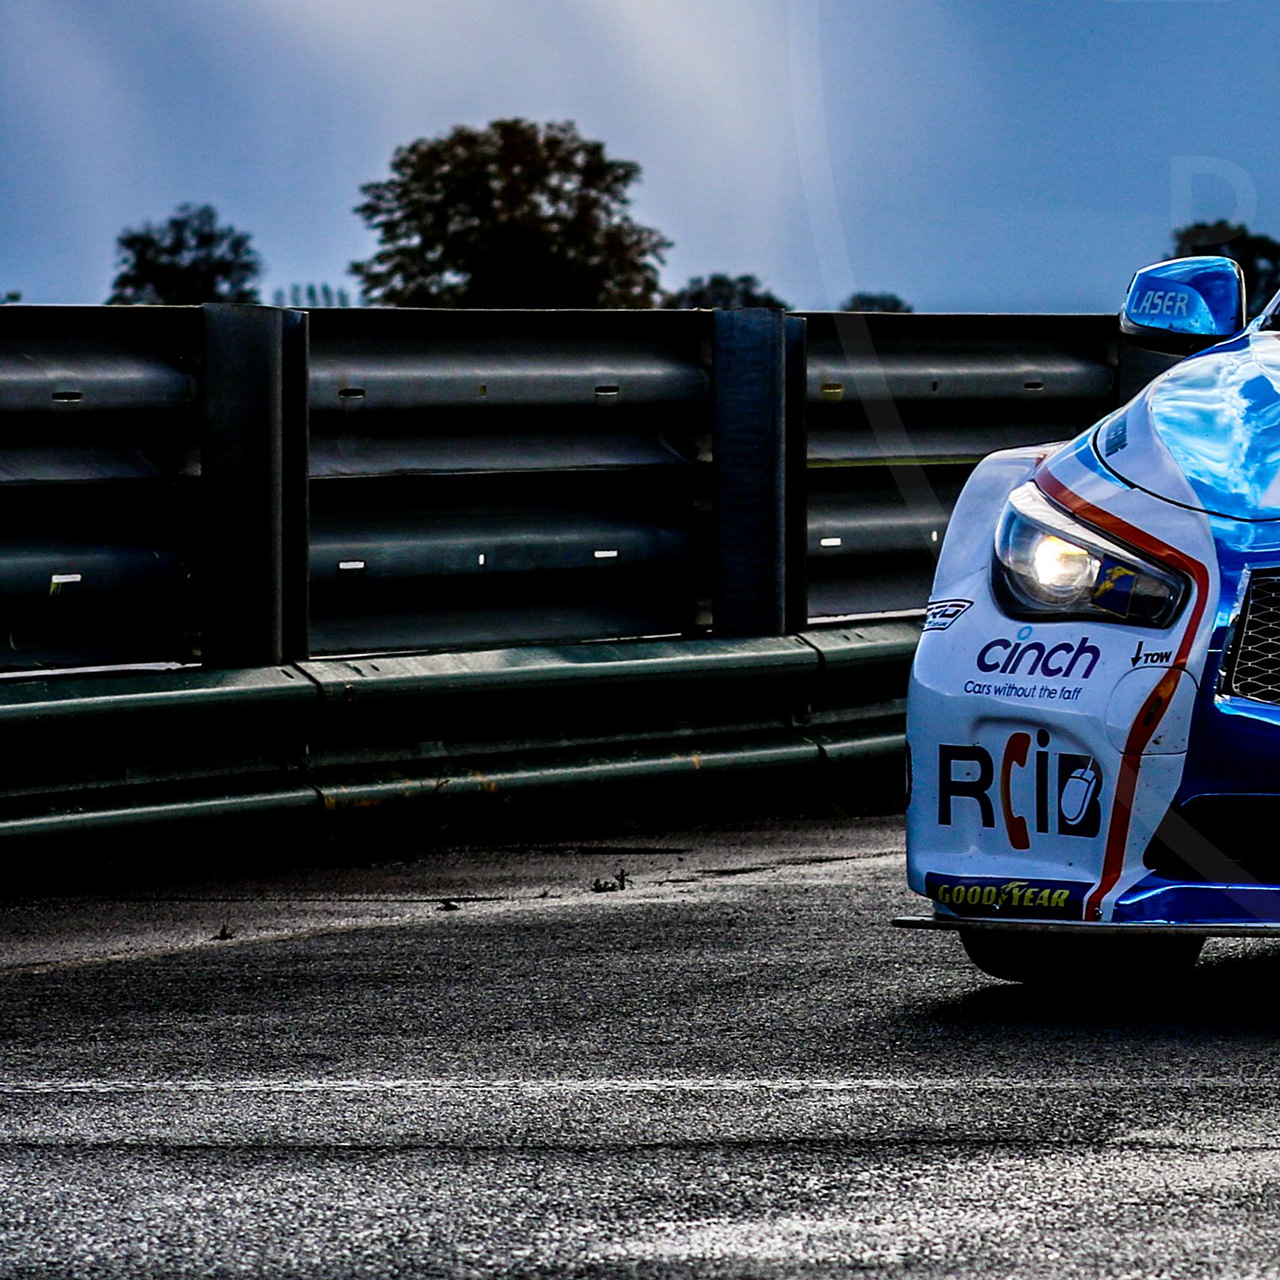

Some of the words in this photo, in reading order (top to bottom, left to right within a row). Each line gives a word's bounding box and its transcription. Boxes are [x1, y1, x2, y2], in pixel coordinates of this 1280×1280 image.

[1130, 290, 1190, 317] LASER
[975, 625, 1101, 681] cinch
[1143, 650, 1172, 665] TOW
[963, 679, 992, 696] Cars
[994, 682, 1035, 699] without
[1038, 686, 1058, 700] the
[1058, 686, 1082, 701] faff
